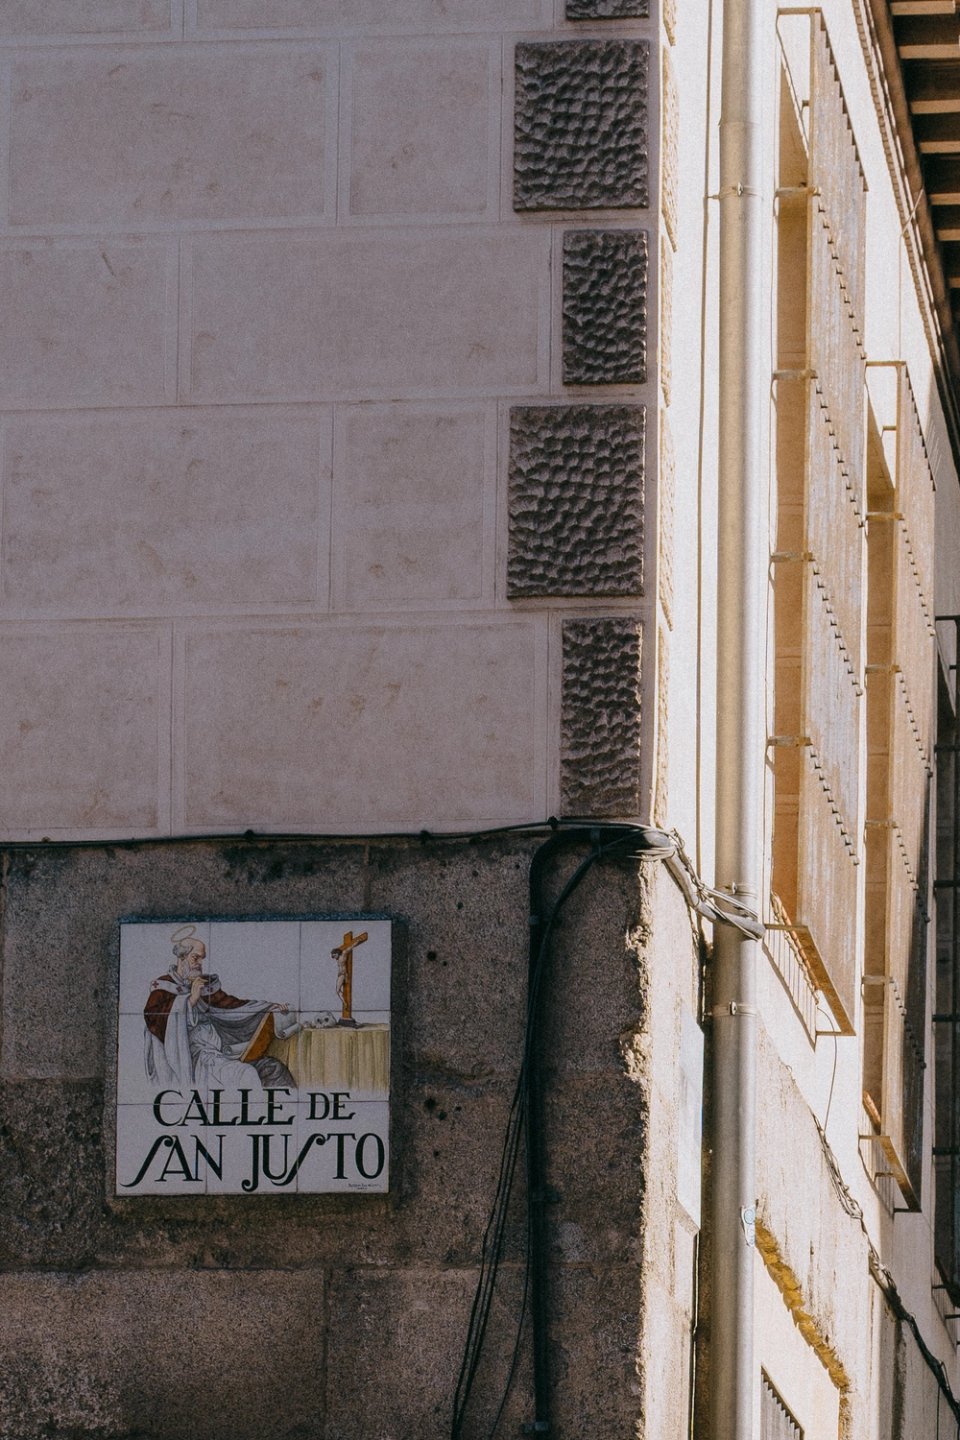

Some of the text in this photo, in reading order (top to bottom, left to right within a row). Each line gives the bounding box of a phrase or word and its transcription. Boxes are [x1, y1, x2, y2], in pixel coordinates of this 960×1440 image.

[152, 1088, 356, 1127] CALLE DE
[120, 1132, 386, 1193] SAN JUSTO
